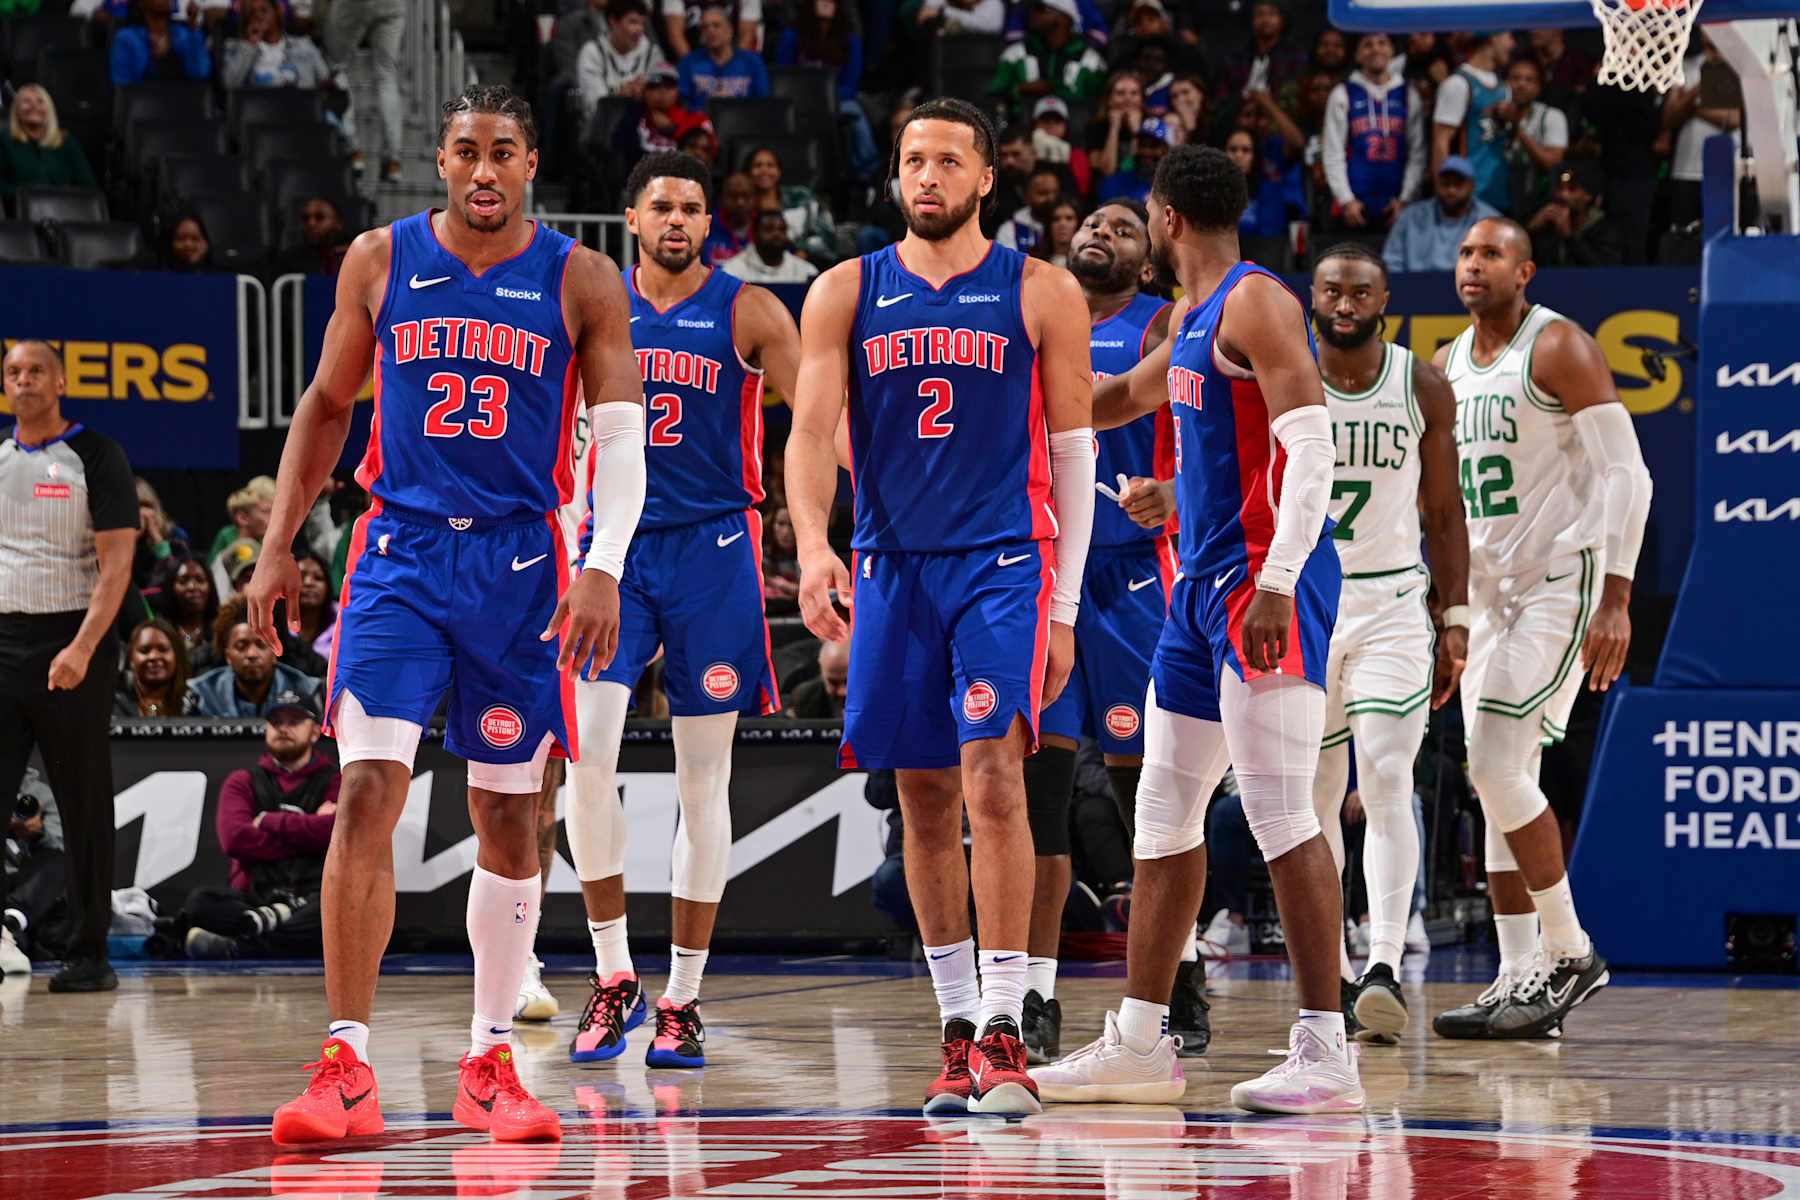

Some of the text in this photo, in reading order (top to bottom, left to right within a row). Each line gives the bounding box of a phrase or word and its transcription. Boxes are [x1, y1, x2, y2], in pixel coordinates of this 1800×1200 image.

[496, 287, 541, 301] StockX
[958, 294, 1000, 304] StockX
[391, 317, 551, 377] DETROIT
[677, 319, 715, 329] StockX
[634, 348, 722, 394] TROIT
[863, 327, 1009, 377] DETROIT
[424, 372, 509, 439] 23
[643, 393, 683, 446] 2
[918, 378, 954, 438] 2
[1456, 394, 1518, 446] ELTICS
[1333, 420, 1409, 470] LTICS
[1330, 480, 1372, 540] 7
[1461, 454, 1519, 518] 42
[487, 725, 515, 735] PISTONS
[488, 718, 515, 728] DETROIT
[1665, 765, 1800, 803] FORD
[1665, 812, 1800, 849] HEAL
